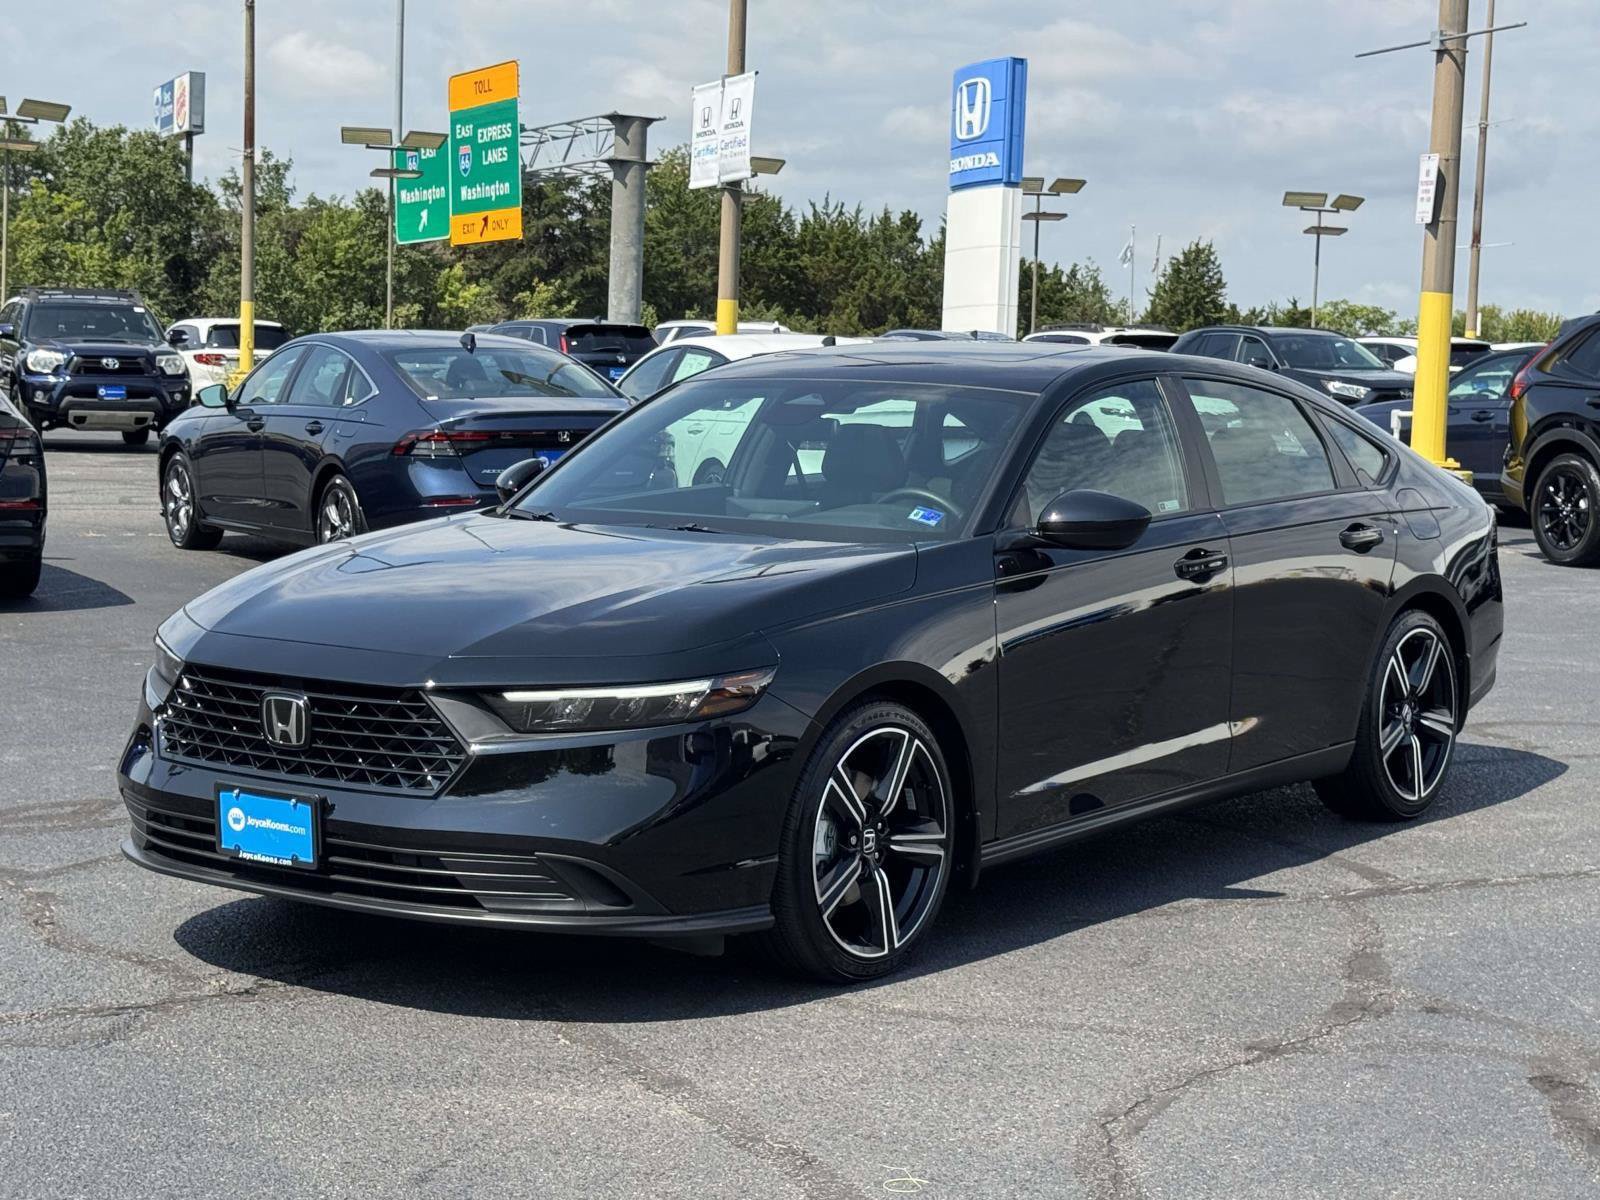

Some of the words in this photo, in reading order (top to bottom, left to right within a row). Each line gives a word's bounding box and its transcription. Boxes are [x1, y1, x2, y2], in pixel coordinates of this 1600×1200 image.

[473, 79, 492, 95] TOLL
[456, 124, 473, 139] EAST
[477, 122, 512, 143] EXPRESS
[696, 129, 716, 138] HONDA
[724, 120, 744, 130] HONDA
[482, 147, 508, 165] LANES
[950, 152, 1000, 174] HONDA
[400, 185, 445, 204] Washington
[460, 180, 510, 202] Washington
[462, 222, 477, 235] EXIT
[491, 219, 510, 231] ONLY
[247, 816, 306, 835] JoyceKoons.com
[239, 850, 292, 866] JoyceKoons.com
